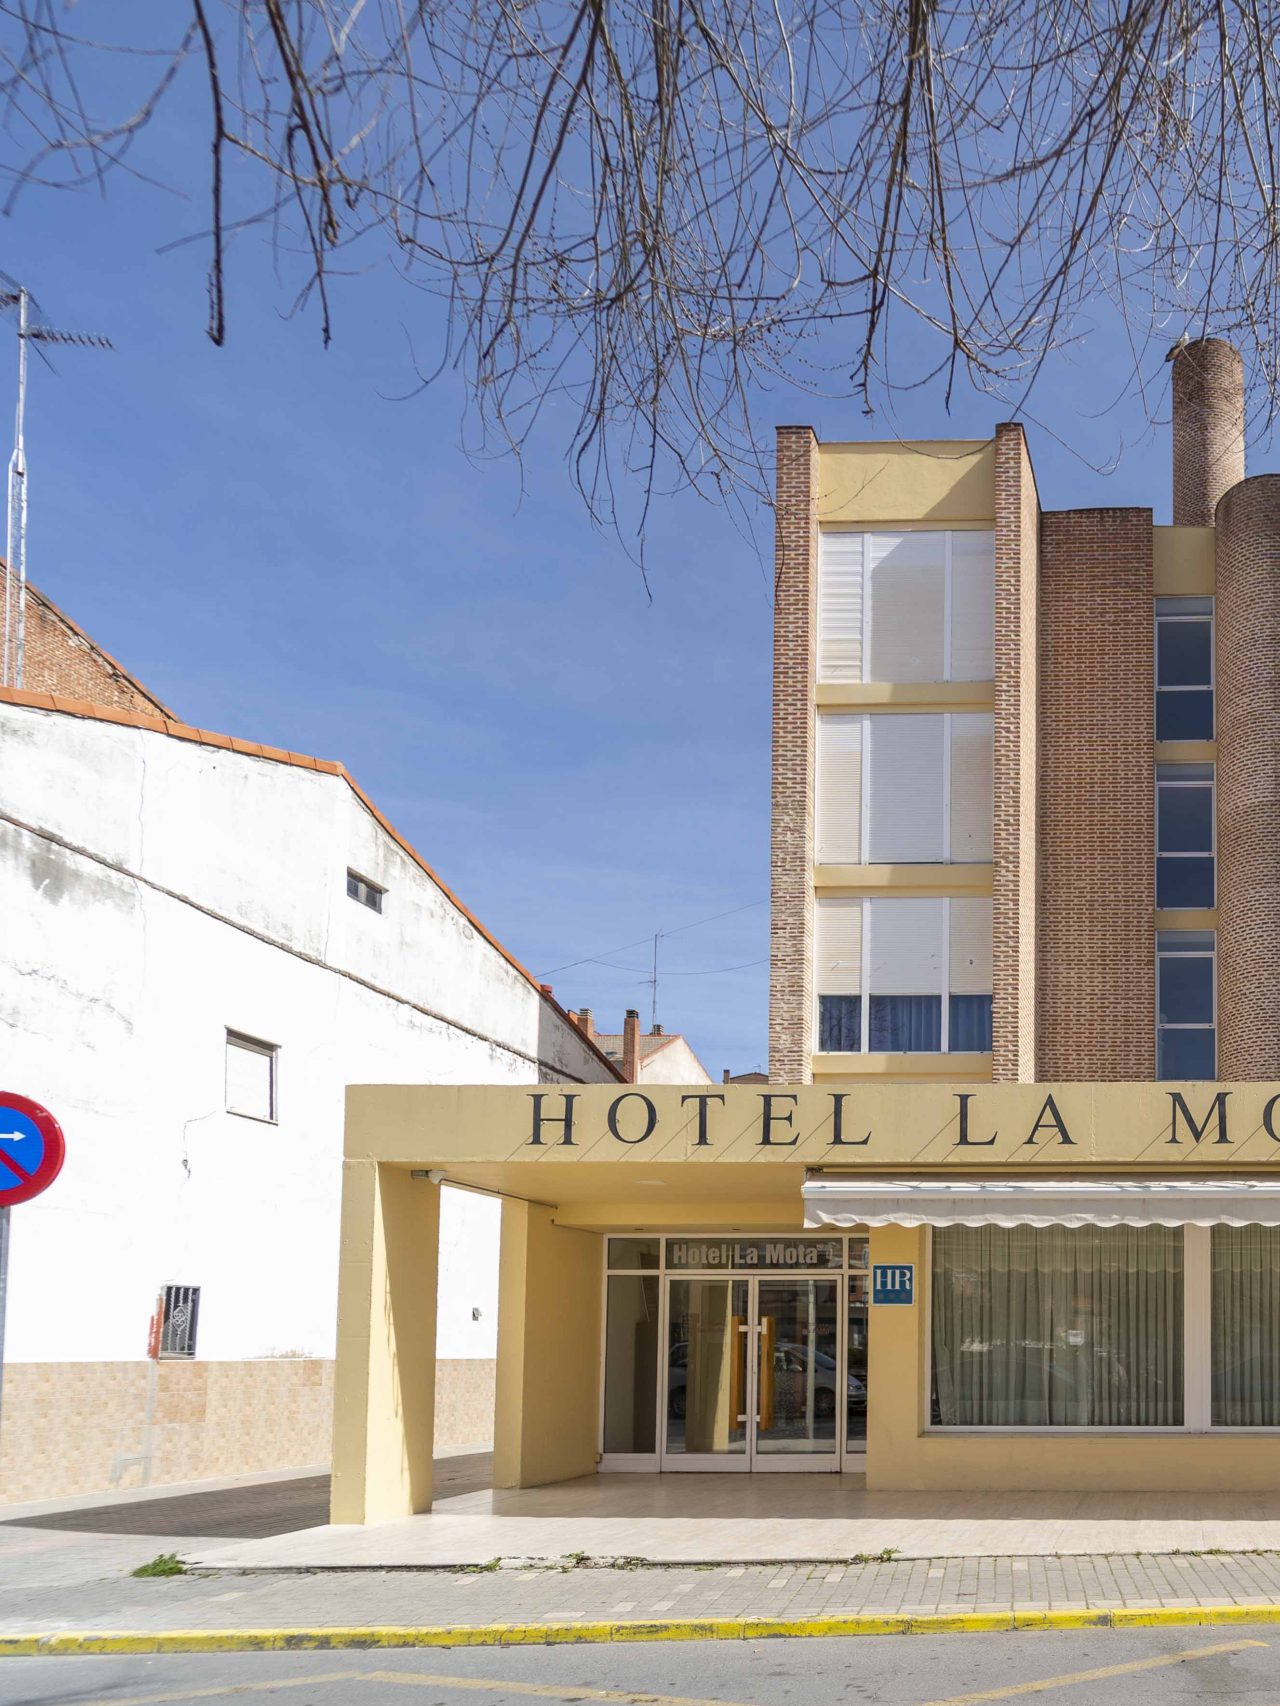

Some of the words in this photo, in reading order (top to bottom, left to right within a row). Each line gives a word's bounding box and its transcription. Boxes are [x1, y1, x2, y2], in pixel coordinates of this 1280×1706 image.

[526, 1092, 872, 1146] HOTEL
[953, 1093, 1078, 1146] LA
[673, 1244, 727, 1264] Hotel
[734, 1244, 758, 1264] La
[765, 1244, 818, 1264] Mota
[875, 1269, 911, 1290] HR
